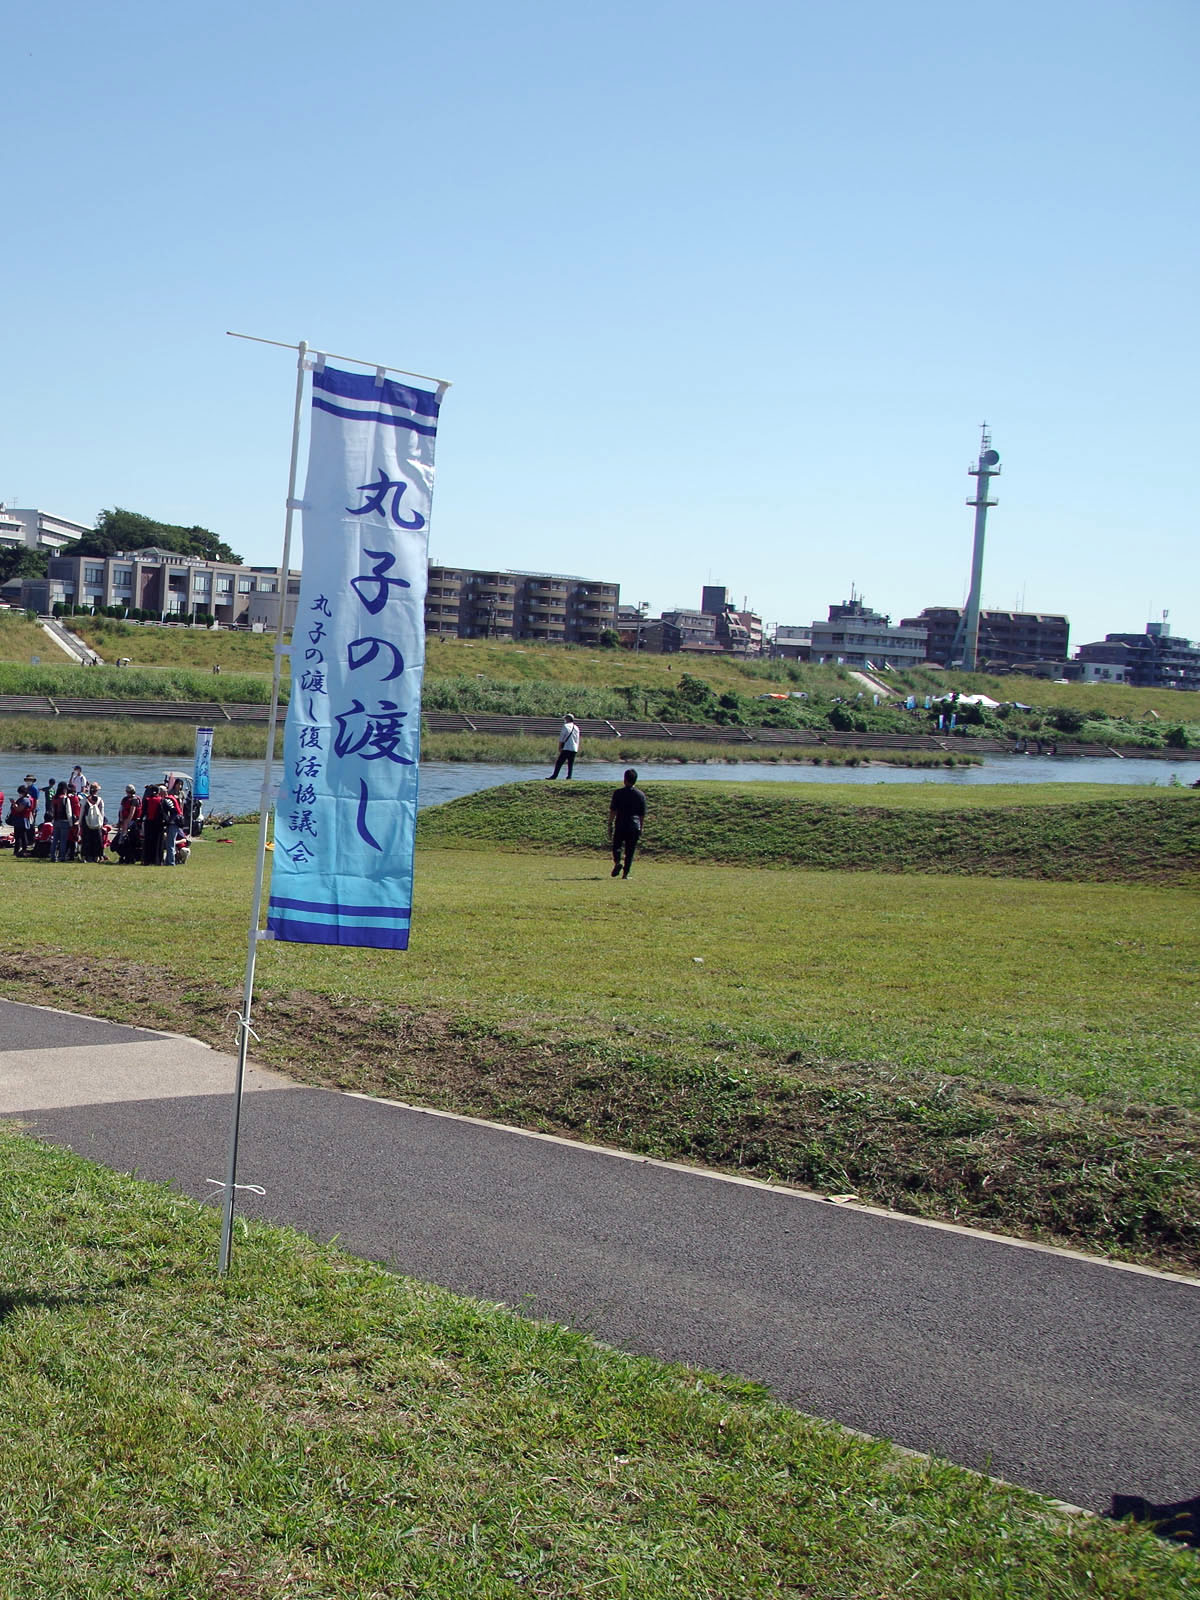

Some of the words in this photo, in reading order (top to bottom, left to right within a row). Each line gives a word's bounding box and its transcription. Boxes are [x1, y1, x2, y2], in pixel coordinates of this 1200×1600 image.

[287, 594, 332, 863] 丸子の渡し復活協議会
[335, 468, 425, 851] 丸子の渡し
